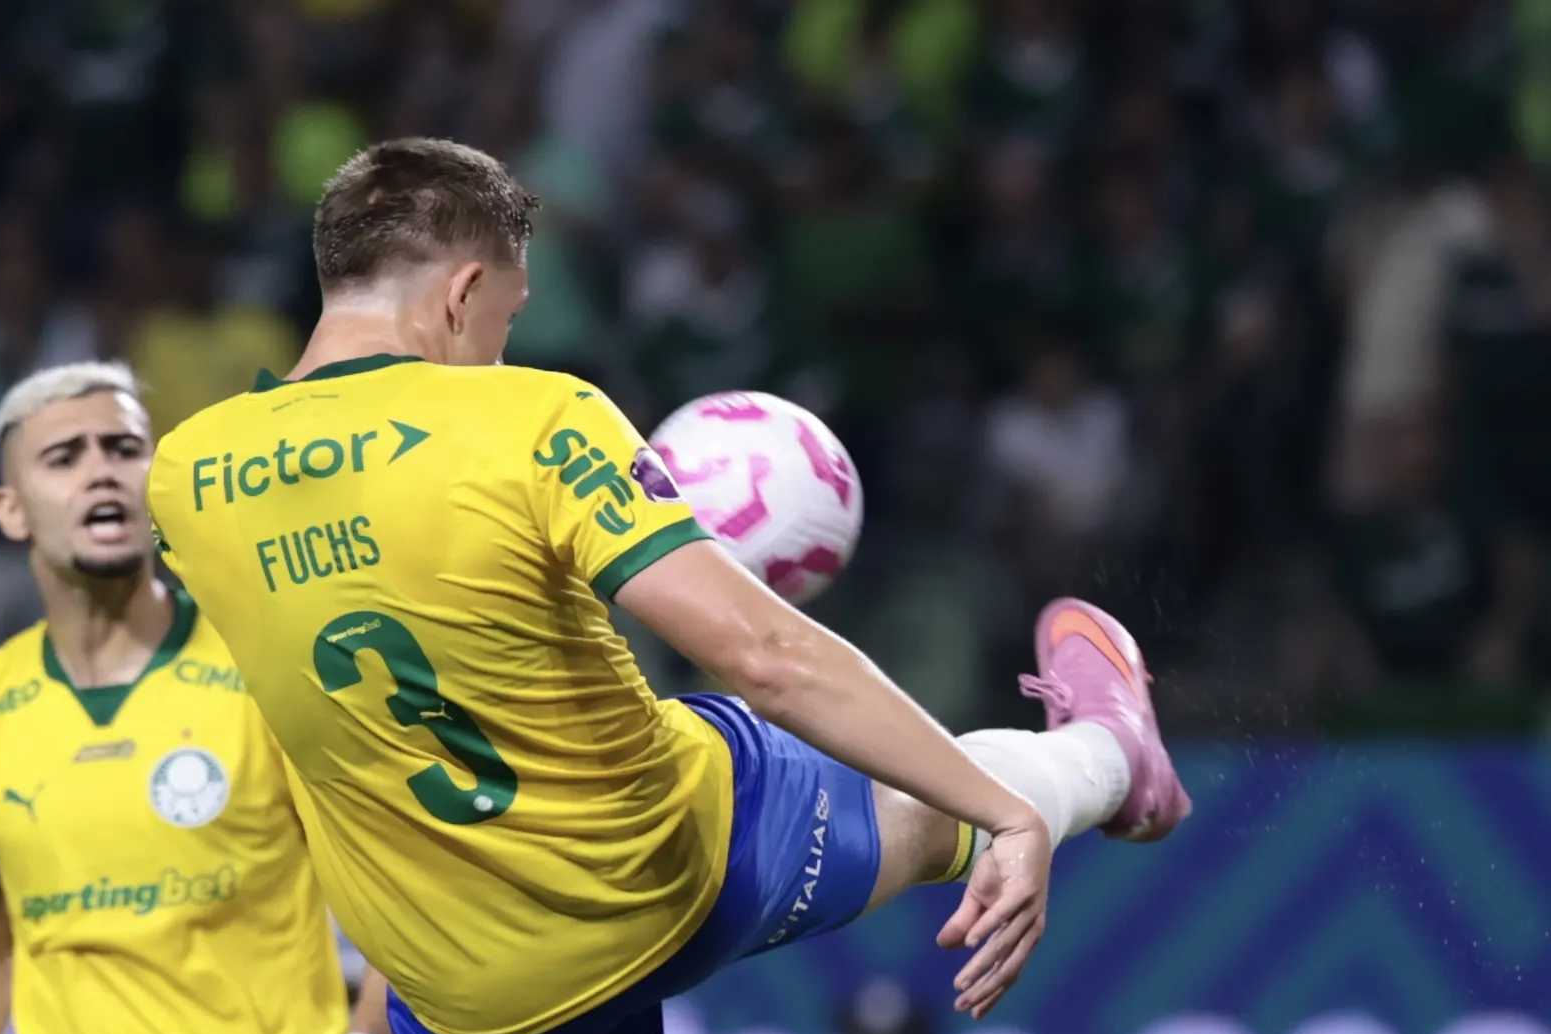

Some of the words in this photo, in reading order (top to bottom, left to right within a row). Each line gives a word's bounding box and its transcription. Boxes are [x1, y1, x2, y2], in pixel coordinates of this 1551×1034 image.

[193, 430, 378, 512] Fictor
[256, 515, 381, 593] FUCHS
[313, 610, 519, 825] 3
